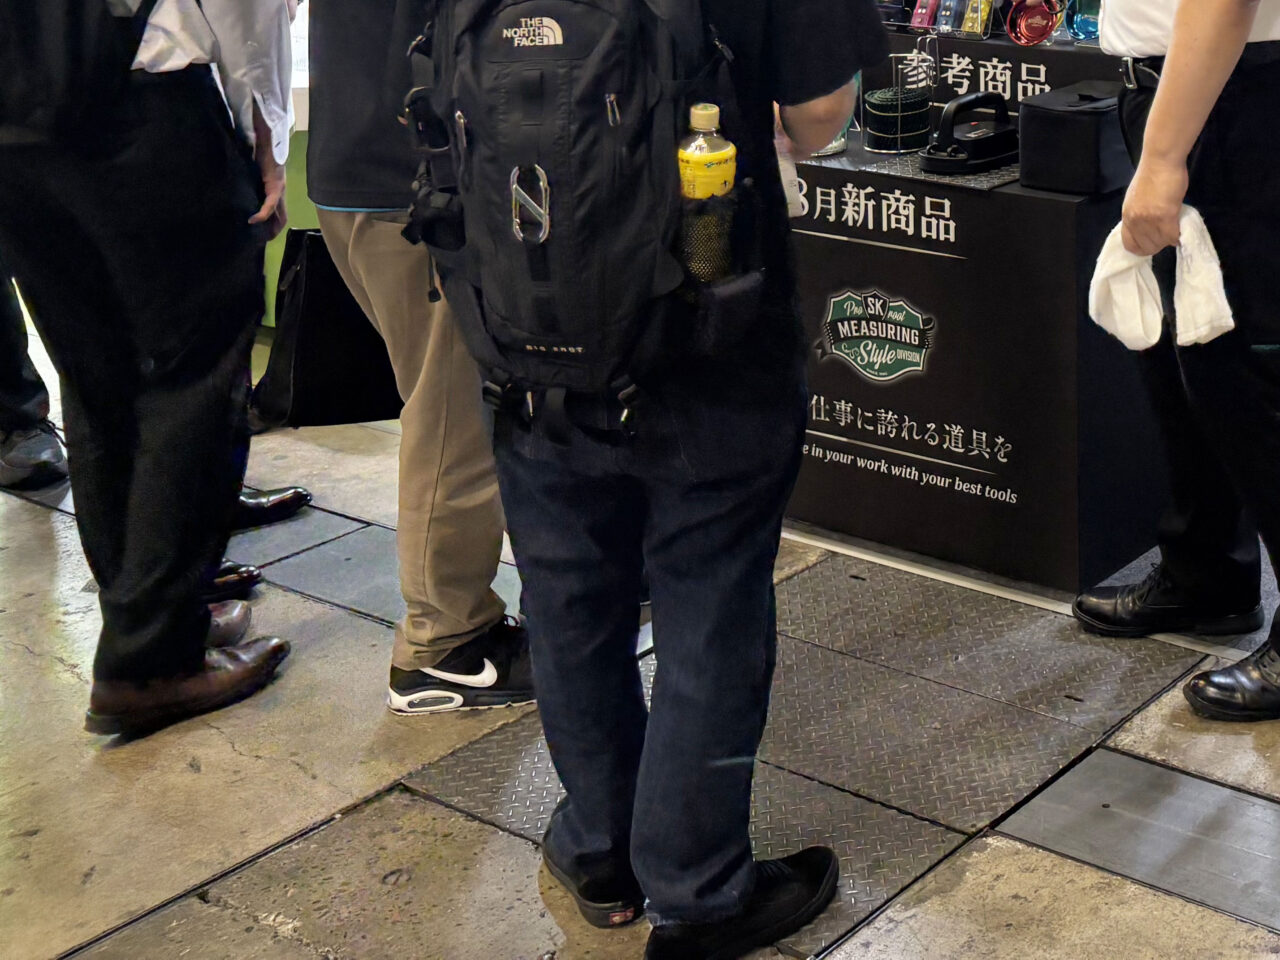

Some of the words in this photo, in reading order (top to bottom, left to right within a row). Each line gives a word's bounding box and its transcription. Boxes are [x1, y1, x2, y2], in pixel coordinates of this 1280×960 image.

[503, 26, 543, 38] NORTH
[520, 17, 543, 28] THE
[514, 36, 544, 47] FACE
[867, 296, 884, 316] SK
[837, 319, 919, 345] MEASURING
[857, 340, 897, 370] Style
[809, 394, 1013, 462] 仕事に誇れる道具を
[811, 446, 823, 459] in
[824, 450, 854, 465] your
[856, 453, 889, 474] work
[891, 462, 920, 481] with
[920, 469, 952, 488] your
[954, 477, 982, 496] best
[985, 484, 1018, 504] tools
